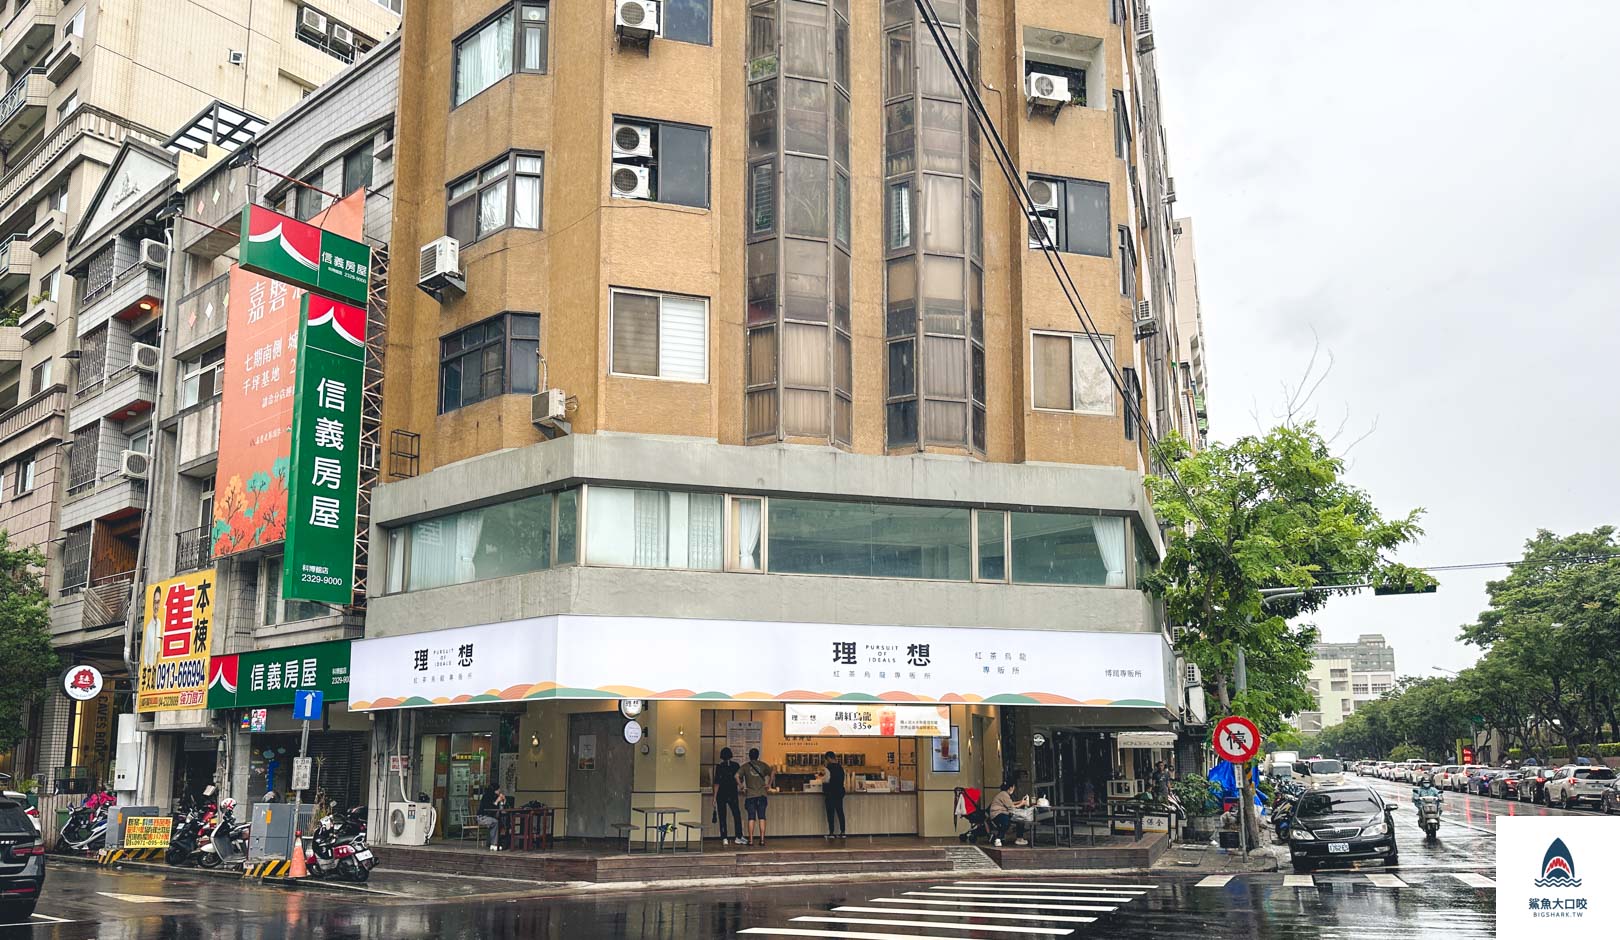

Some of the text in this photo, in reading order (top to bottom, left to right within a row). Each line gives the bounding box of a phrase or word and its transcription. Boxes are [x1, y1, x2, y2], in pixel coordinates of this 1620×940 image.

[322, 251, 367, 277] 信義房屋
[244, 337, 283, 372] 七期南側
[242, 366, 280, 396] 千坪基地
[309, 377, 347, 529] 信義房屋
[301, 573, 343, 586] 2329-9000
[162, 584, 195, 657] 售
[193, 579, 211, 654] 本棟
[413, 643, 474, 671] 理 想
[833, 641, 931, 667] 理 想
[156, 658, 206, 690] 0913-666994
[250, 658, 317, 692] 信義房屋
[1226, 731, 1247, 750] 停
